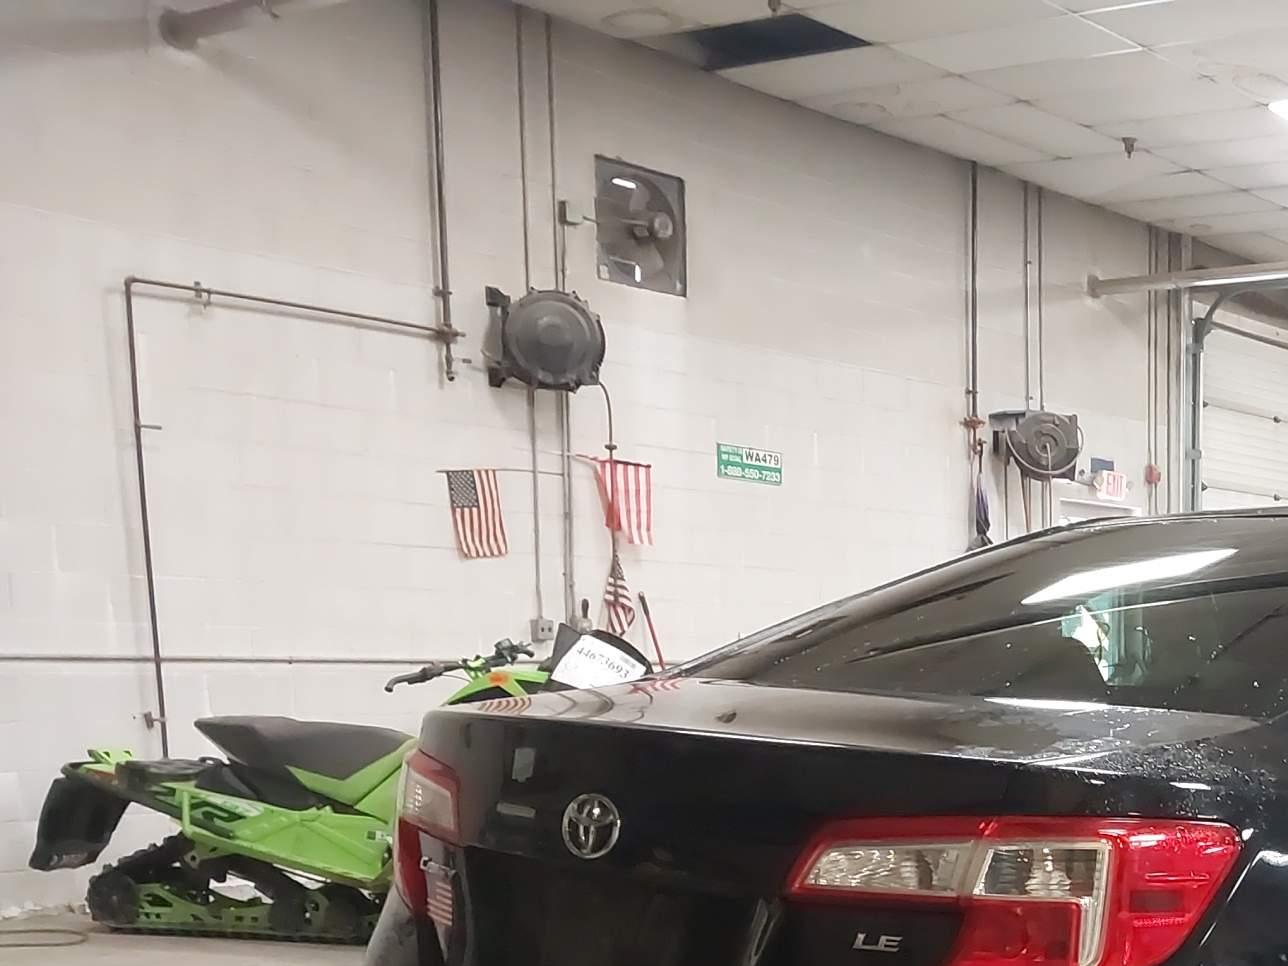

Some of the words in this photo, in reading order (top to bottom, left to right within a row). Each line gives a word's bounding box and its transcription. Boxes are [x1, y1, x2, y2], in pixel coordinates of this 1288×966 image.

[744, 450, 780, 466] WA479
[1106, 472, 1124, 498] EXIT
[852, 932, 904, 953] LE
